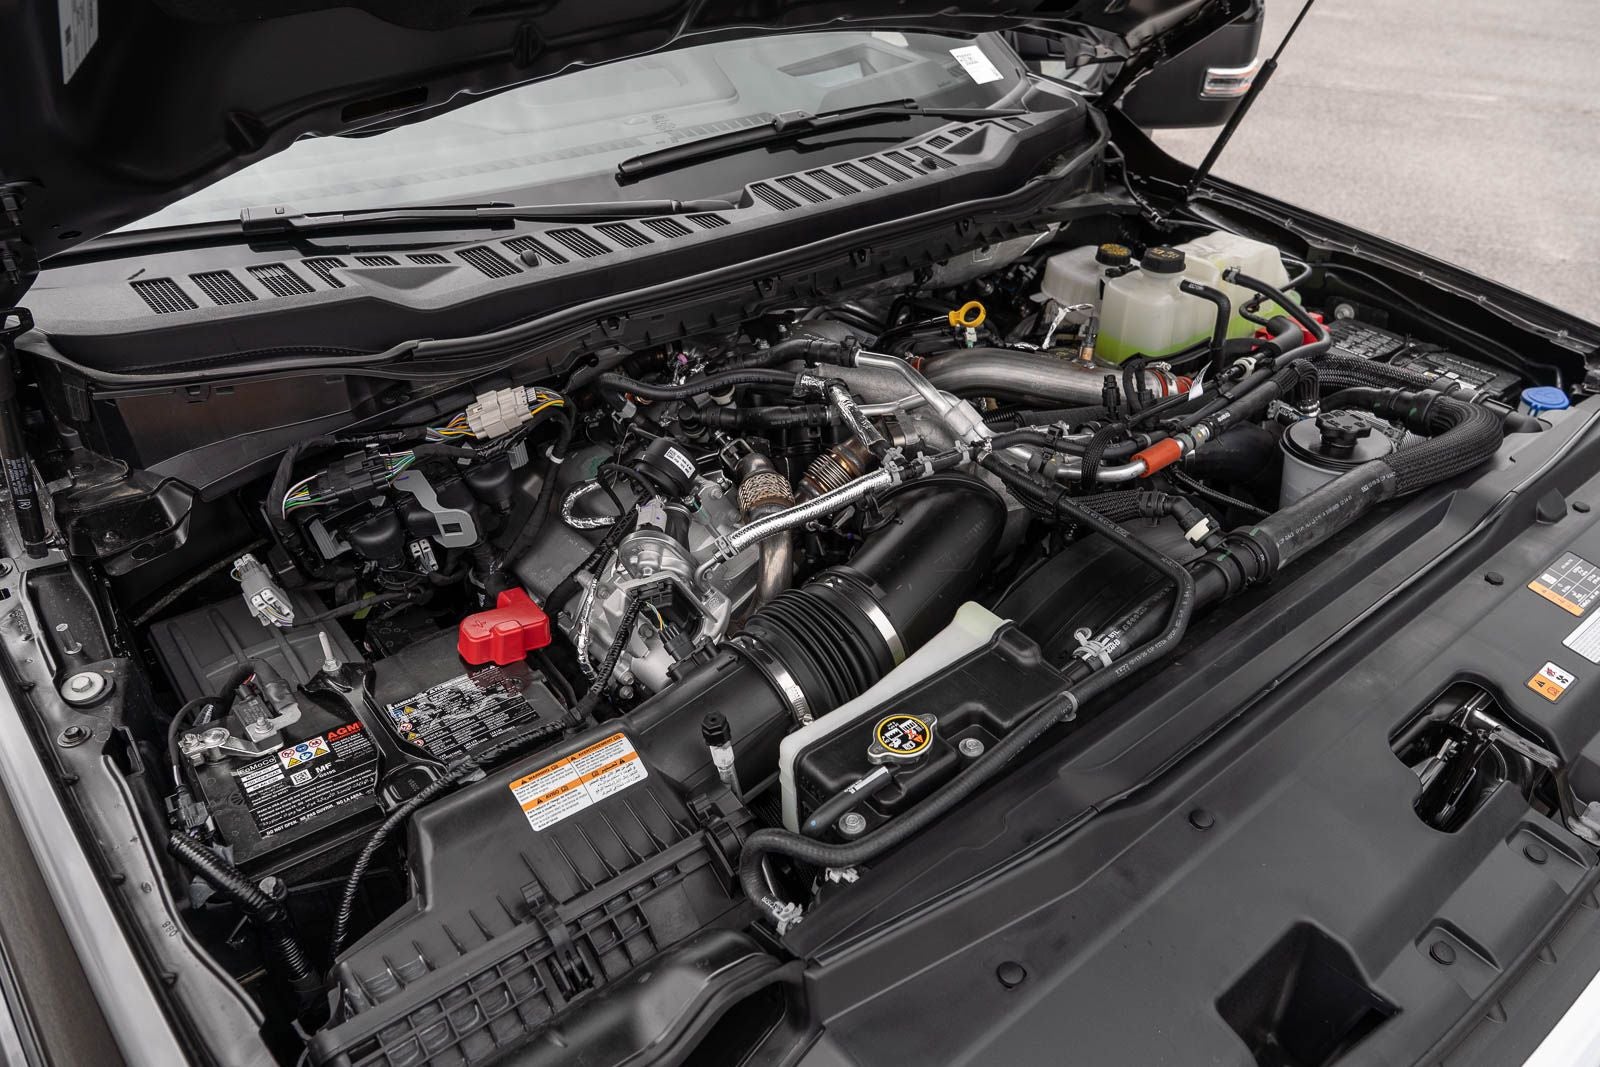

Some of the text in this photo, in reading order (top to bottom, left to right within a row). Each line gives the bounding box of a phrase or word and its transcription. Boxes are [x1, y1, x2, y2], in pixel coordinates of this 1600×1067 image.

[327, 723, 360, 740] AGM
[316, 763, 332, 773] MF
[527, 767, 550, 780] WARNING
[546, 790, 559, 799] AVISO
